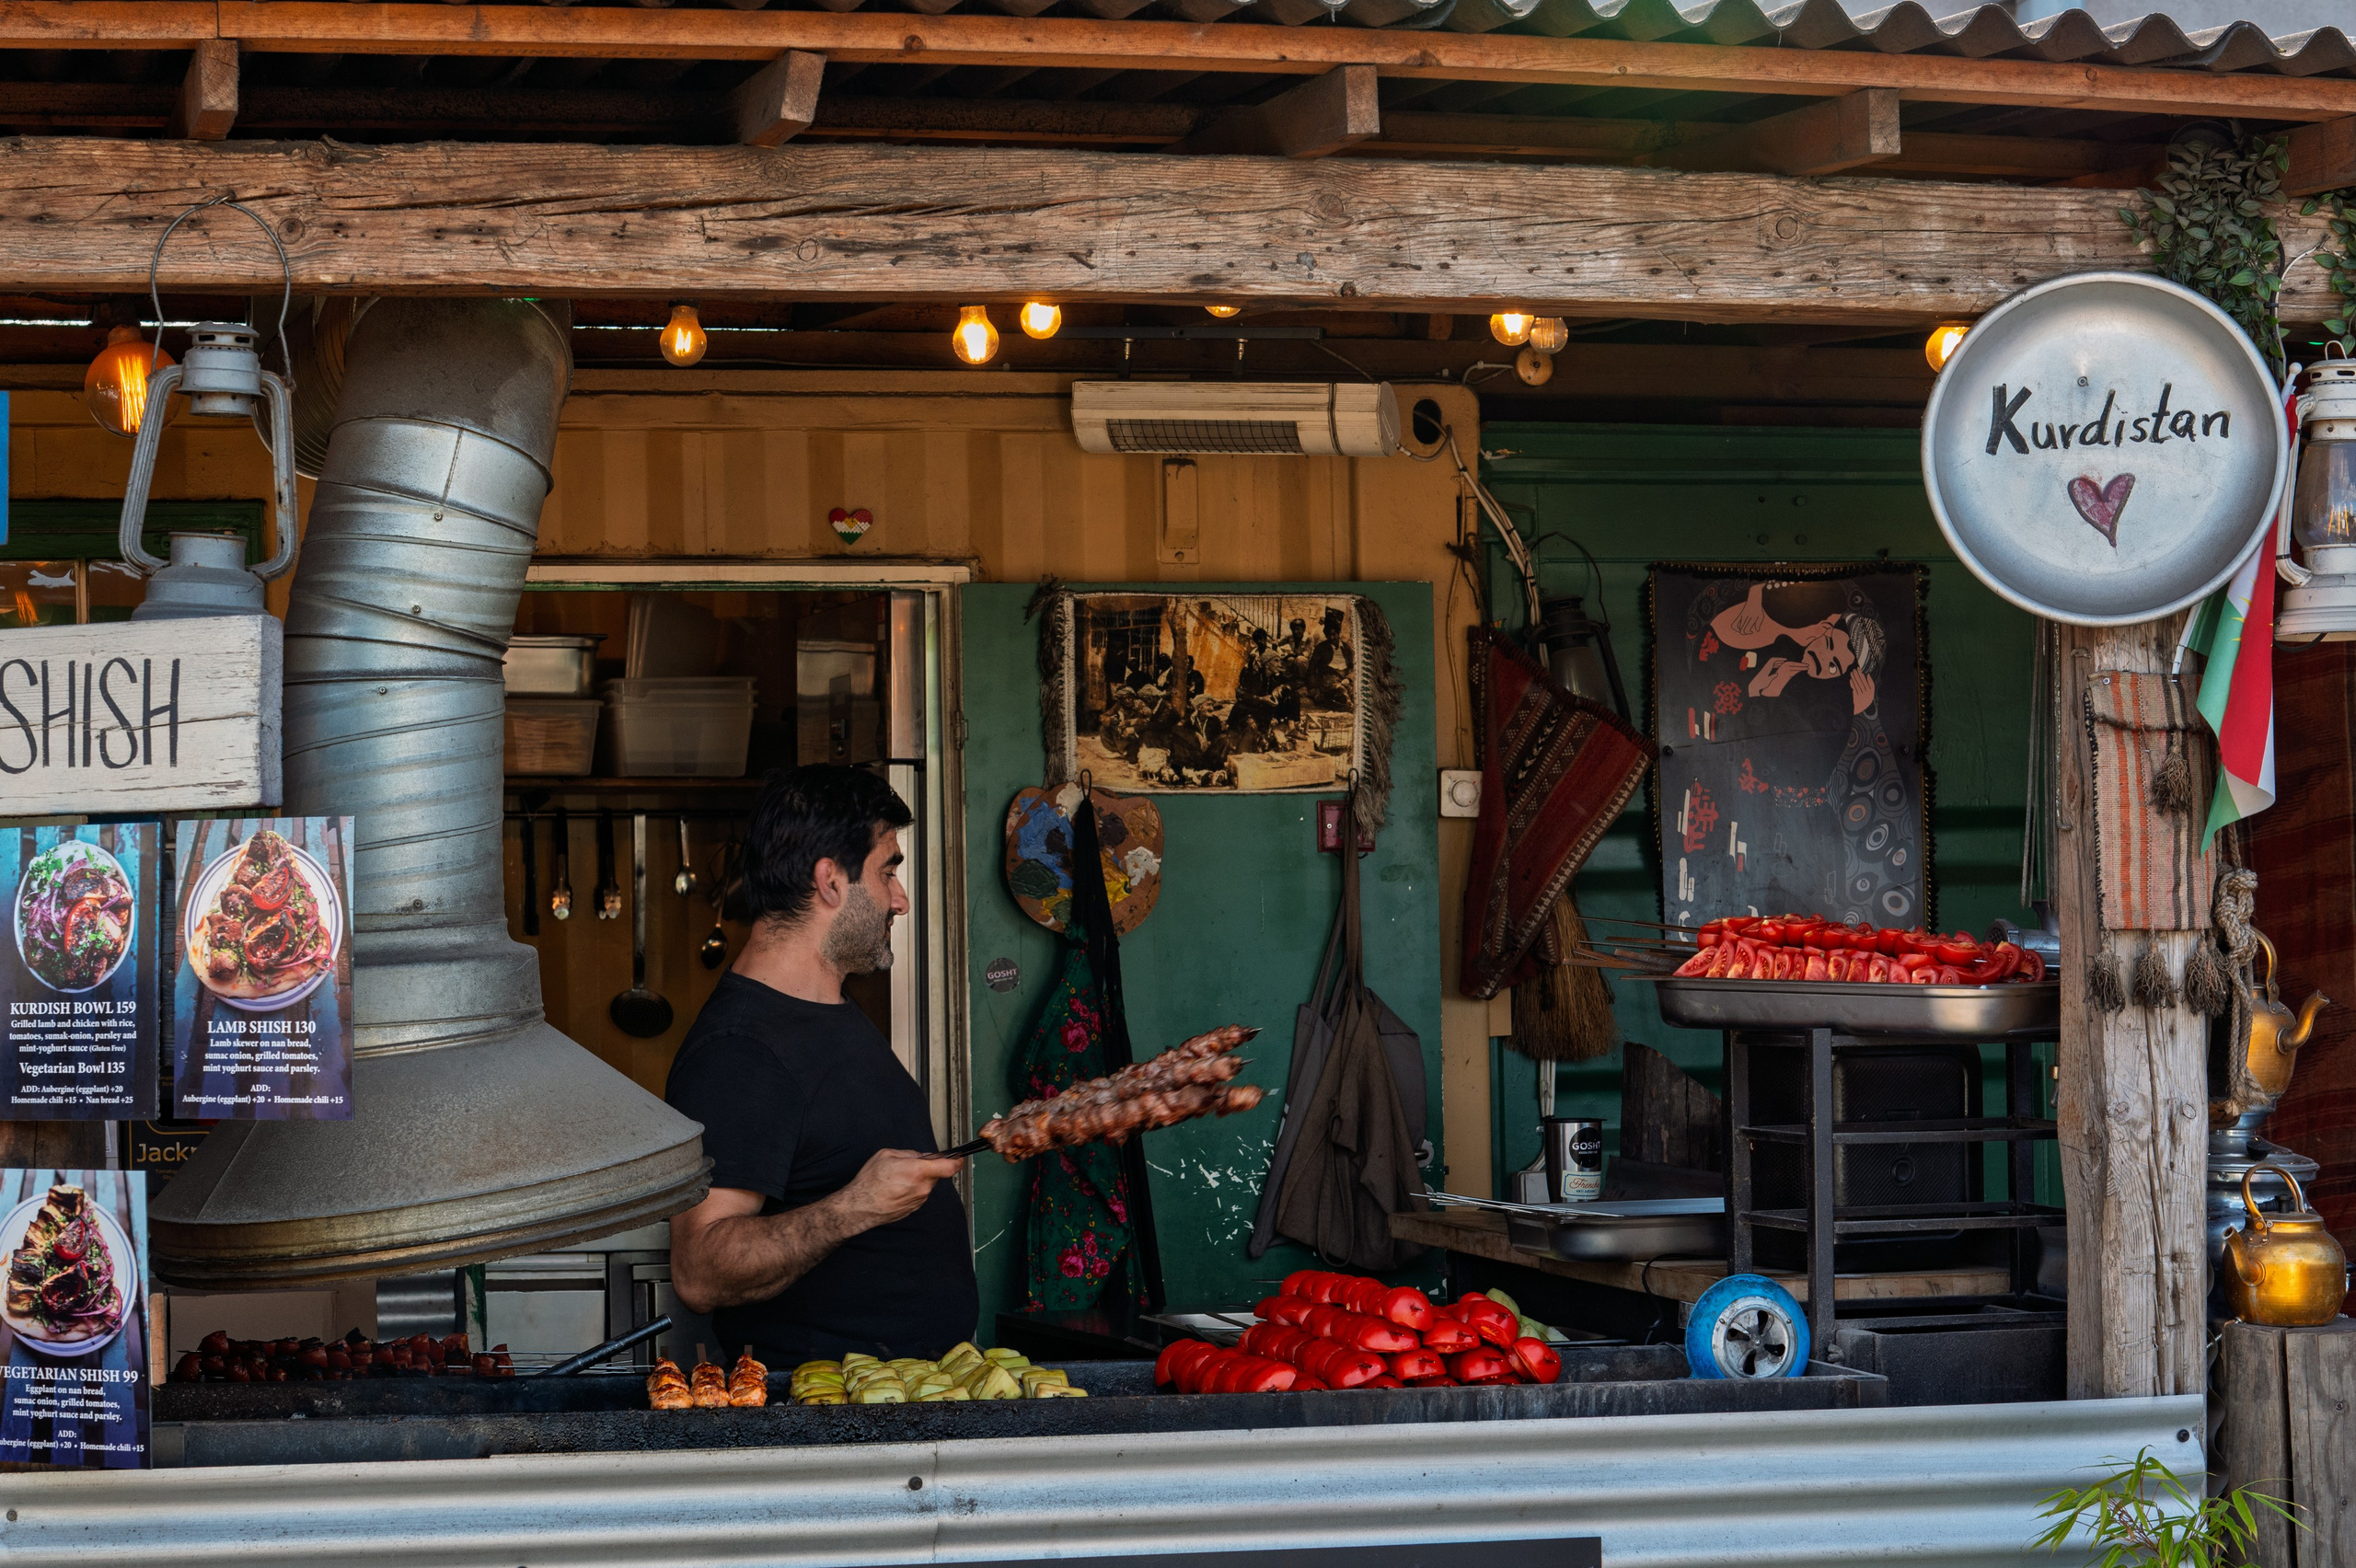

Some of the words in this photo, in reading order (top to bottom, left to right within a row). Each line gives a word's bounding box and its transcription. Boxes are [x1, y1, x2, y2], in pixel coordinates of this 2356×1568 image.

[1985, 382, 2231, 456] Kurdistan
[0, 657, 180, 774] SHISH
[987, 968, 1018, 980] GOSHT
[10, 1002, 71, 1014] KURDISH
[74, 1002, 114, 1014] BOWL
[116, 1001, 136, 1013] 159
[11, 1020, 37, 1028] Grilled
[38, 1020, 55, 1028] lamb
[57, 1020, 71, 1028] and
[72, 1020, 99, 1028] chicken
[119, 1020, 135, 1028] rice,
[207, 1021, 247, 1033] LAMB
[249, 1020, 292, 1033] SHISH
[295, 1021, 316, 1033] 130
[9, 1032, 43, 1041] tomatoes,
[45, 1032, 94, 1041] sumak-onion,
[95, 1032, 121, 1042] parsley
[122, 1031, 136, 1039] and
[19, 1044, 66, 1054] mint-yoghurt
[89, 1044, 110, 1053] (Gluten
[111, 1044, 126, 1053] Free)
[210, 1039, 231, 1047] Lamb
[233, 1039, 259, 1047] skewer
[287, 1039, 311, 1048] bread,
[230, 1053, 254, 1061] onion,
[255, 1052, 280, 1061] grilled
[282, 1053, 318, 1061] tomatoes,
[19, 1062, 75, 1077] Vegetarian
[77, 1062, 105, 1074] Bowl
[107, 1062, 125, 1074] 135
[222, 1064, 251, 1074] yoghurt
[291, 1065, 320, 1074] parsley.
[41, 1086, 75, 1094] Aubergine
[75, 1085, 110, 1094] (eggplant)
[182, 1095, 216, 1104] Aubergine
[217, 1095, 251, 1104] (eggplant)
[136, 1141, 198, 1163] Jack
[1572, 1141, 1600, 1151] GOSHT
[80, 1368, 120, 1382] SHISH
[123, 1371, 138, 1383] 99
[26, 1384, 56, 1395] Eggplant
[84, 1388, 106, 1397] bread,
[61, 1399, 85, 1408] grilled
[86, 1401, 120, 1409] tomatoes,
[30, 1410, 58, 1419] yoghurt
[80, 1412, 93, 1420] and
[95, 1412, 122, 1423] parsley.
[0, 1439, 26, 1447] ubergine
[28, 1440, 58, 1449] (eggplant)
[80, 1442, 116, 1451] Homemade
[117, 1444, 131, 1452] chili
